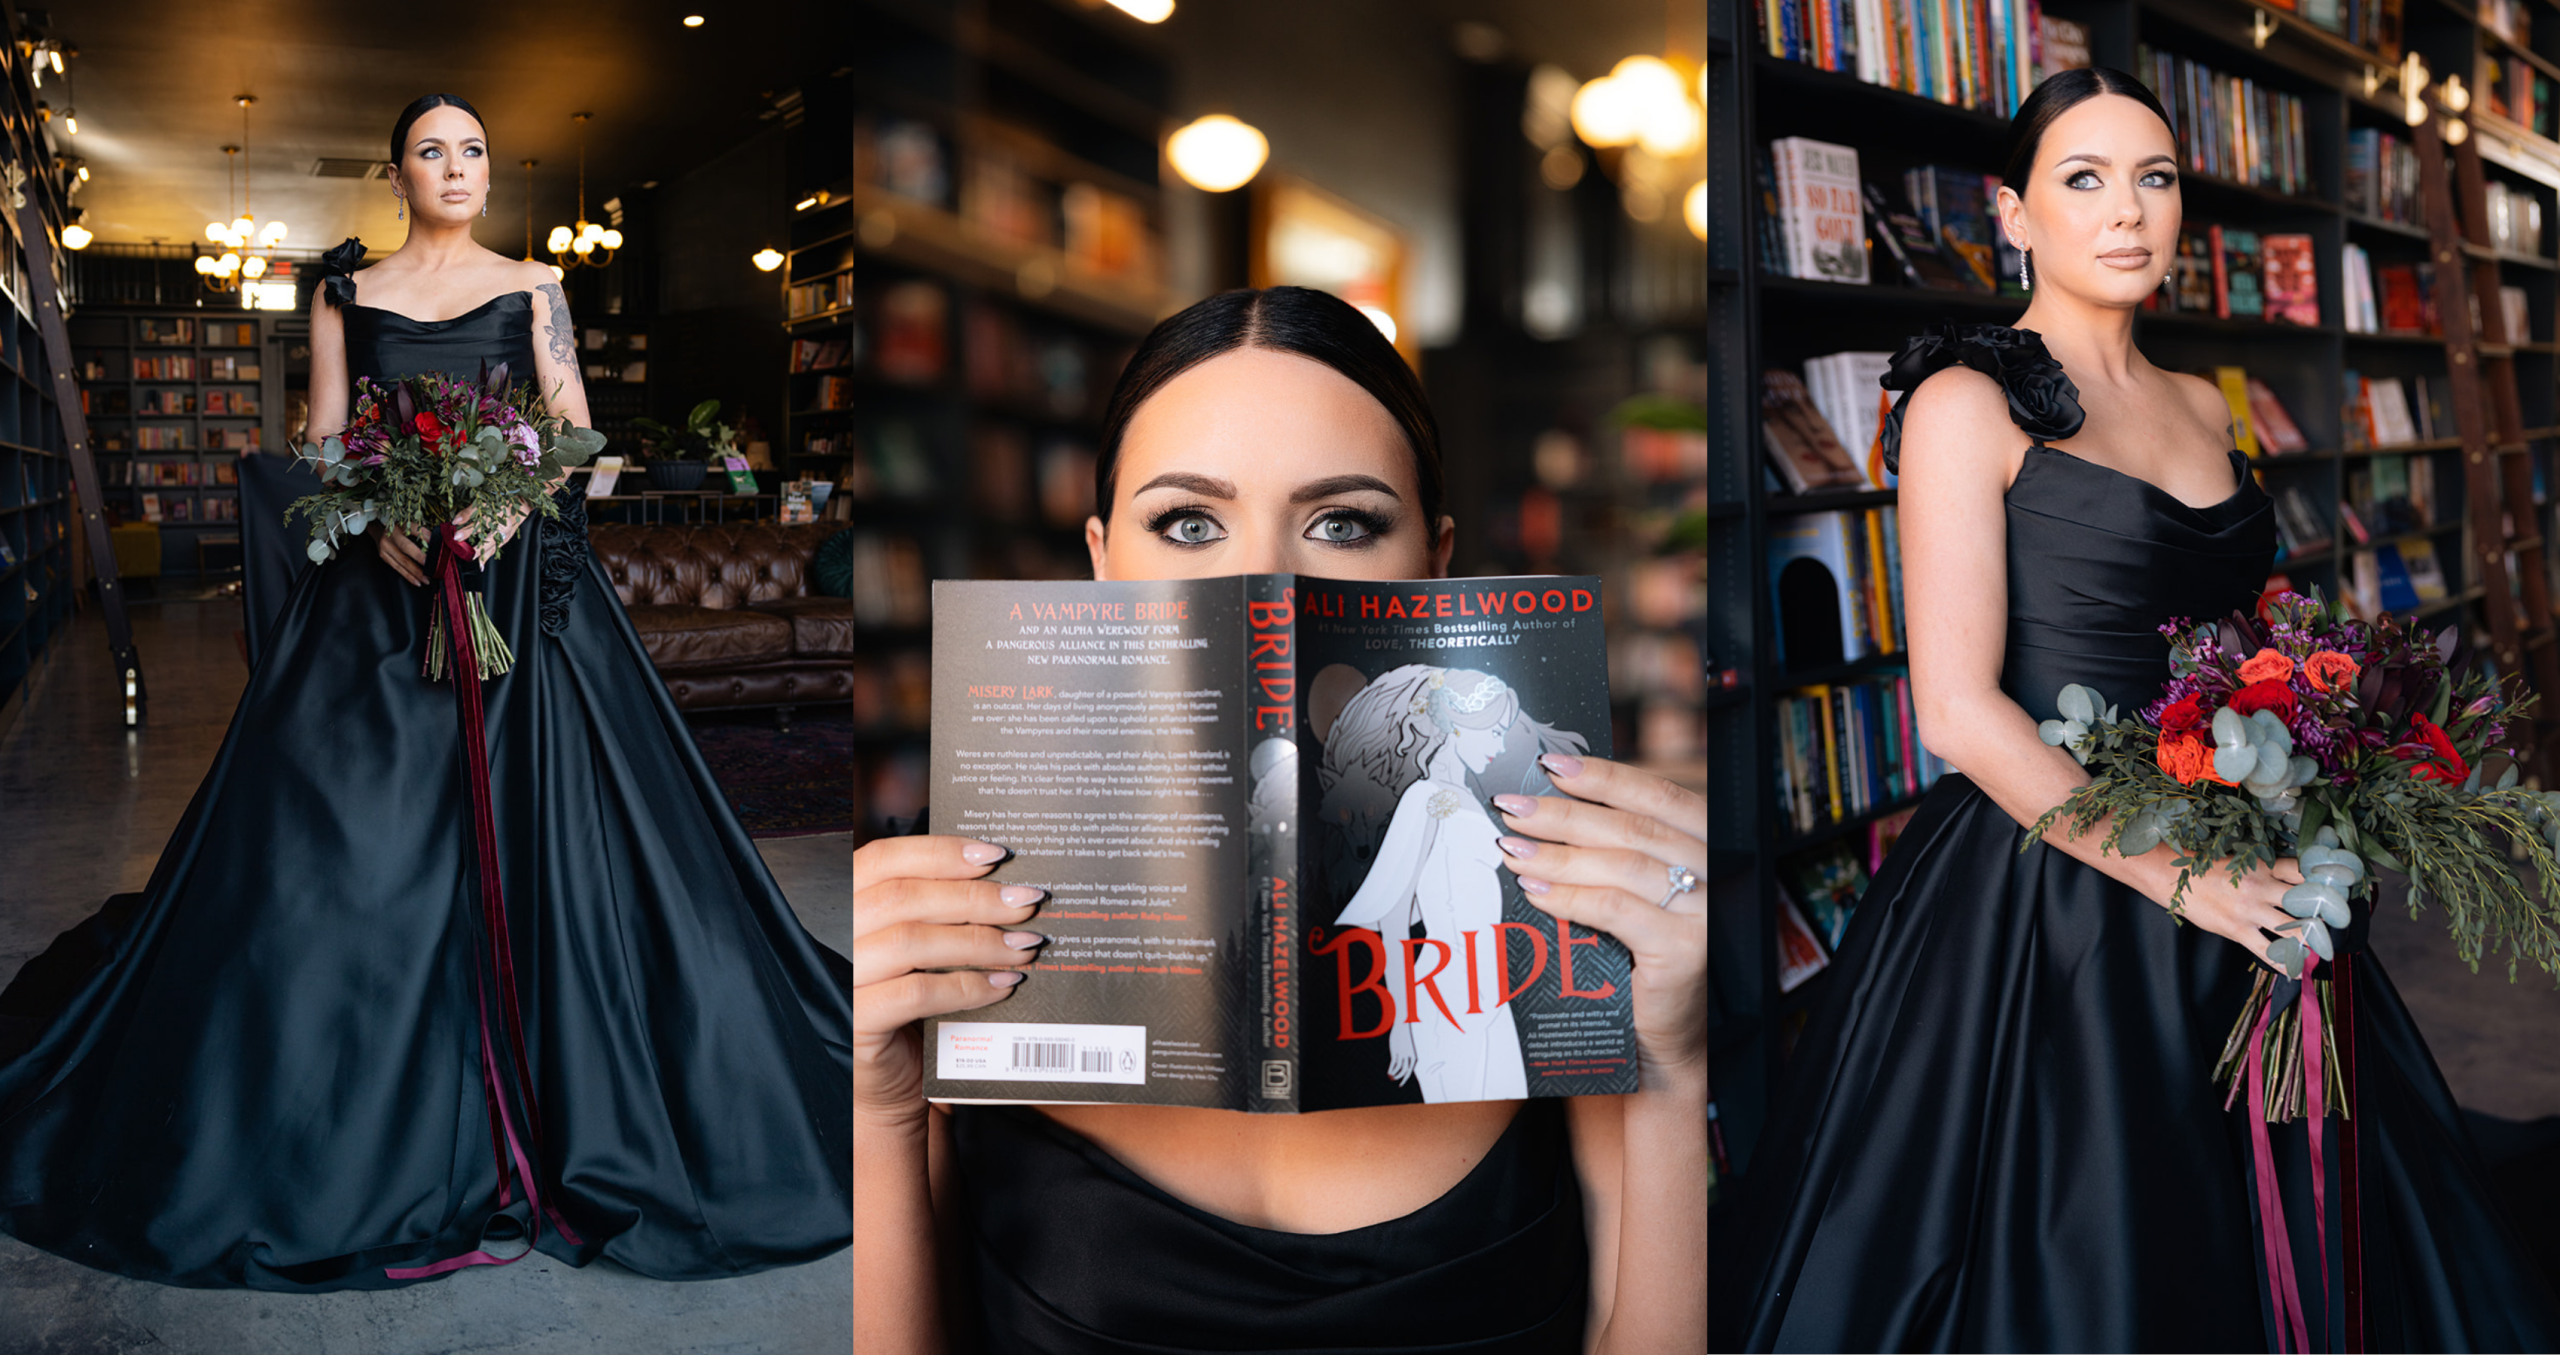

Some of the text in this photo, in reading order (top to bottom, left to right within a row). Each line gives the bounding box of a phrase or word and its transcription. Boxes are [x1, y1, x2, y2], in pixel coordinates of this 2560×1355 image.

[1304, 589, 1594, 618] ALI HAZELWOOD
[1009, 601, 1189, 621] A VAMPYRE BRIDE
[1018, 625, 1179, 636] AND AN ALPHA WEREWOLF FORM
[1318, 618, 1576, 635] #1 New York Times Bestselling Author of
[985, 638, 1208, 651] A DANGEROUS ALLIANCE IN THIS ENTHRALLING
[1365, 634, 1521, 650] LOVE, THEORETICALLY
[1027, 654, 1170, 665] NEW PARANORMAL ROMANCE.
[1248, 588, 1296, 730] BRIDE
[968, 685, 1016, 699] MISERY
[1058, 690, 1094, 700] daughter
[1095, 690, 1104, 698] of
[1112, 689, 1147, 700] powerful
[1148, 689, 1181, 700] Vampyre
[973, 701, 980, 710] is
[992, 701, 1023, 710] outcast.
[1026, 701, 1041, 710] Her
[1042, 701, 1061, 712] days
[1062, 701, 1071, 710] of
[1072, 701, 1094, 712] living
[1095, 701, 1146, 712] anonymously
[1148, 703, 1174, 712] among
[1007, 714, 1022, 722] she
[1023, 714, 1037, 722] has
[1038, 714, 1059, 722] been
[1060, 714, 1085, 722] called
[1086, 716, 1107, 724] upon
[1108, 714, 1118, 722] to
[1119, 714, 1147, 724] uphold
[1000, 726, 1013, 734] the
[1015, 726, 1054, 737] Vampyres
[1055, 726, 1071, 735] and
[1072, 726, 1090, 735] their
[1092, 726, 1118, 735] mortal
[1119, 726, 1153, 737] enemies,
[1156, 727, 1168, 735] the
[1016, 847, 1027, 855] do
[1029, 847, 1065, 856] whatever
[1066, 848, 1072, 856] it
[1074, 848, 1095, 856] takes
[1096, 848, 1105, 856] to
[1106, 848, 1120, 859] get
[1121, 848, 1140, 857] back
[1052, 882, 1093, 891] unleashes
[1094, 883, 1108, 891] her
[1110, 883, 1147, 894] sparkling
[1148, 883, 1169, 892] voice
[1171, 884, 1187, 892] and
[1051, 897, 1098, 907] paranormal
[1099, 897, 1129, 905] Romeo
[1130, 897, 1146, 905] and
[1058, 935, 1080, 946] gives
[1092, 936, 1141, 947] paranormal,
[1143, 937, 1160, 945] with
[1161, 937, 1175, 945] her
[1176, 937, 1216, 946] trademark
[1052, 949, 1069, 958] and
[1070, 950, 1092, 960] spice
[1094, 950, 1110, 959] that
[1112, 950, 1142, 959] doesn't
[1273, 877, 1290, 1048] ALI HAZELWOOD
[1308, 918, 1617, 1041] BRIDE
[1261, 964, 1271, 1014] Bestselling
[1570, 1009, 1584, 1018] and
[1586, 1009, 1603, 1020] witty
[1605, 1008, 1619, 1017] and
[1538, 1018, 1611, 1031] primal in its intensity.
[1262, 1016, 1272, 1047] Author
[1527, 1027, 1624, 1039] Ali Hazelwood's paranormal
[1527, 1039, 1548, 1048] debut
[1549, 1038, 1587, 1048] introduces
[1594, 1037, 1614, 1046] world
